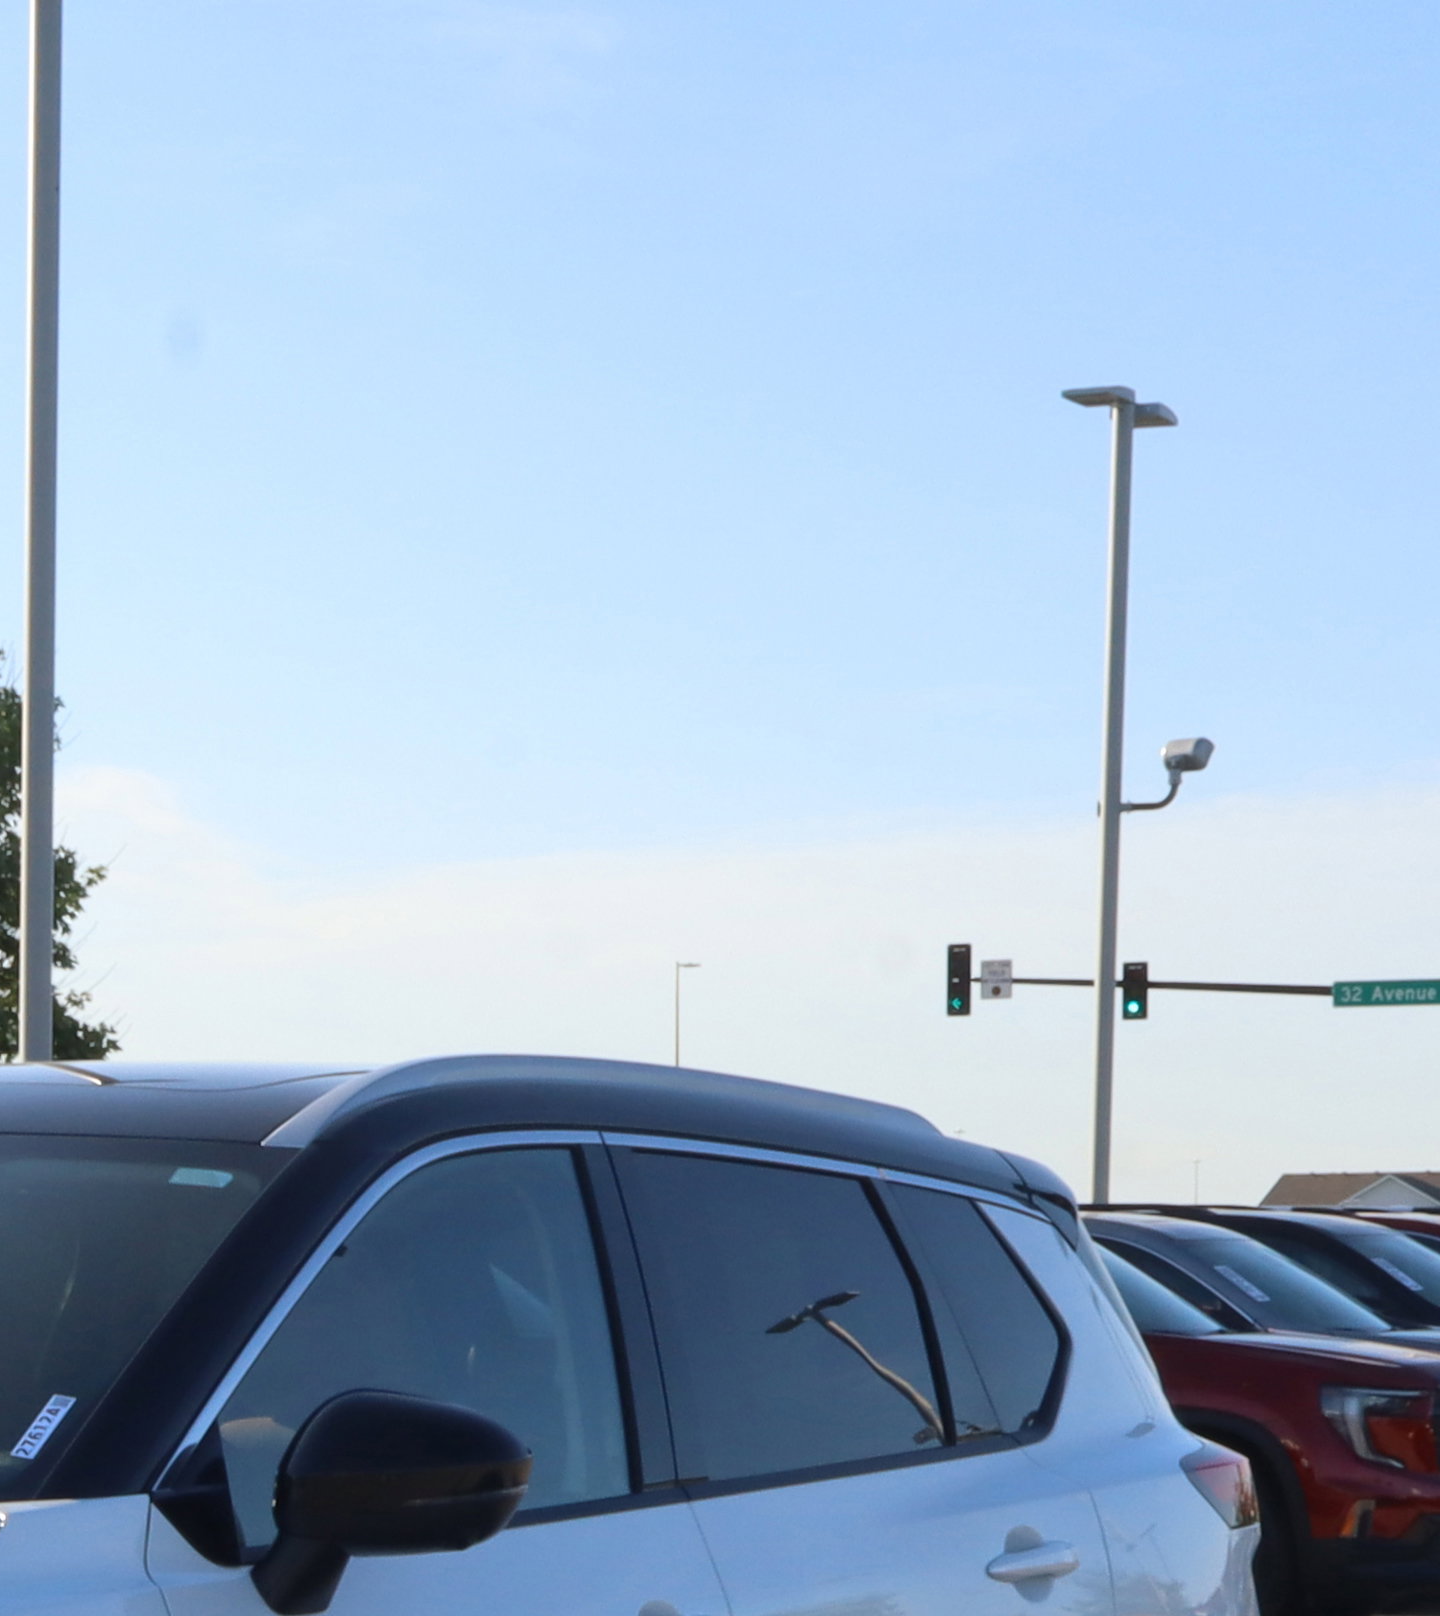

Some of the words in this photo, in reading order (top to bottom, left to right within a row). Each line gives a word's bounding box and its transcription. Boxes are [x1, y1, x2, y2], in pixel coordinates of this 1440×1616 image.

[1340, 986, 1363, 1002] 32
[1371, 985, 1437, 1001] Avenue
[15, 1407, 61, 1457] 27612A
